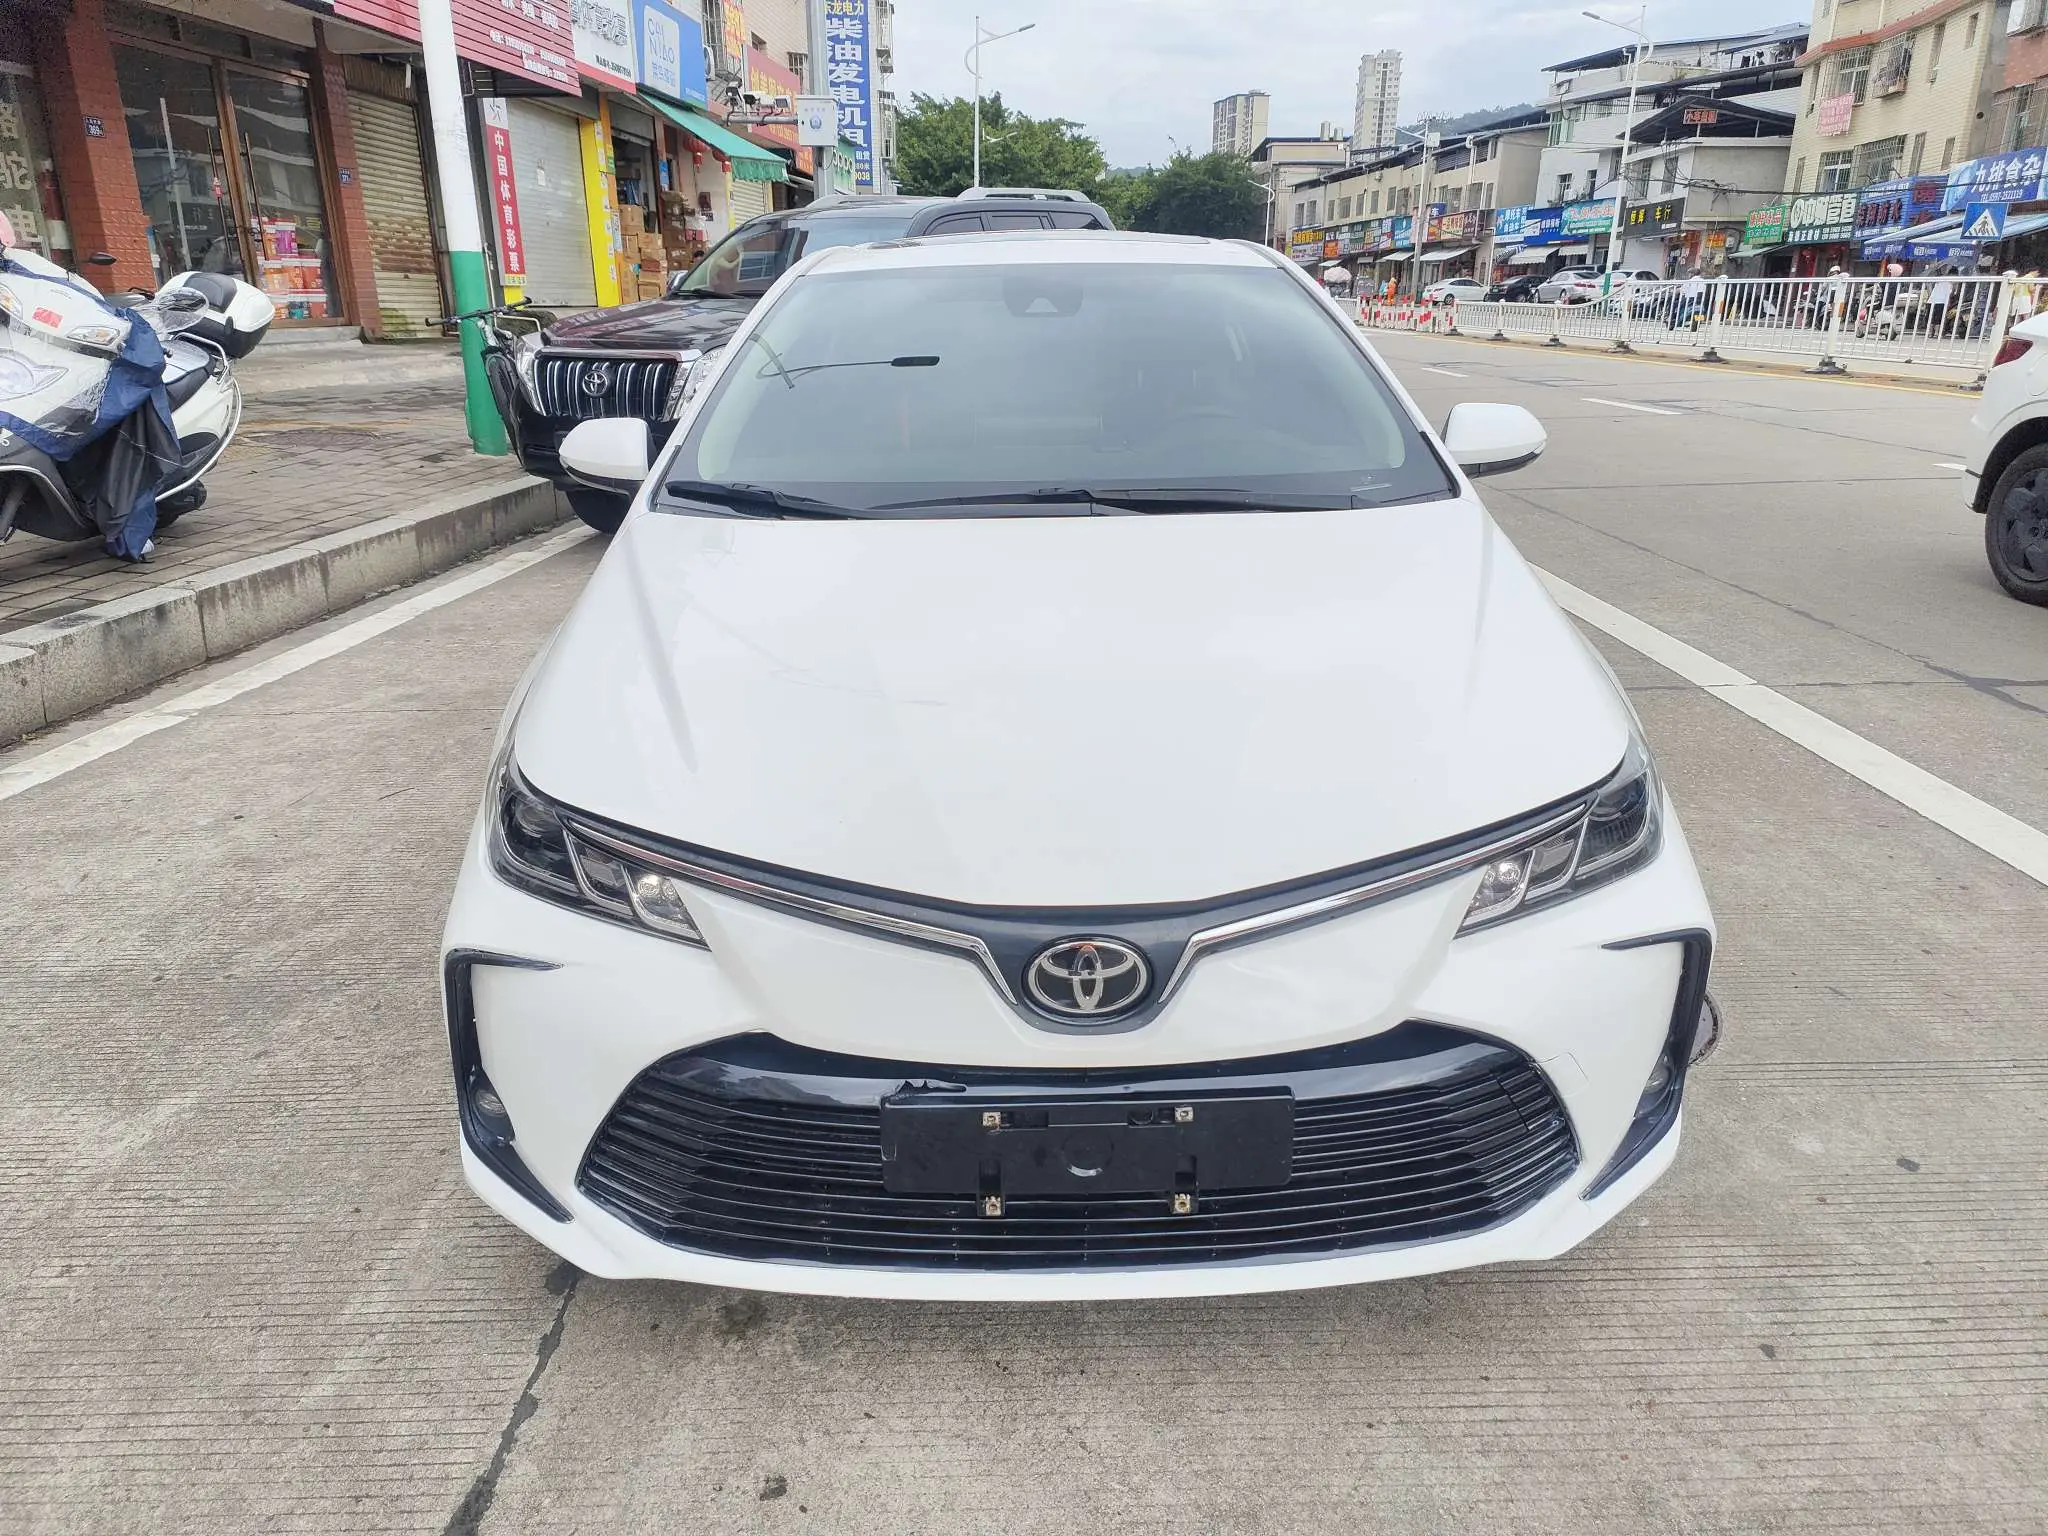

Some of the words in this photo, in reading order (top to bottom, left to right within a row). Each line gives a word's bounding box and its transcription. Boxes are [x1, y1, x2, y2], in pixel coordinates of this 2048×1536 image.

[494, 130, 520, 273] 中国体育彩票
